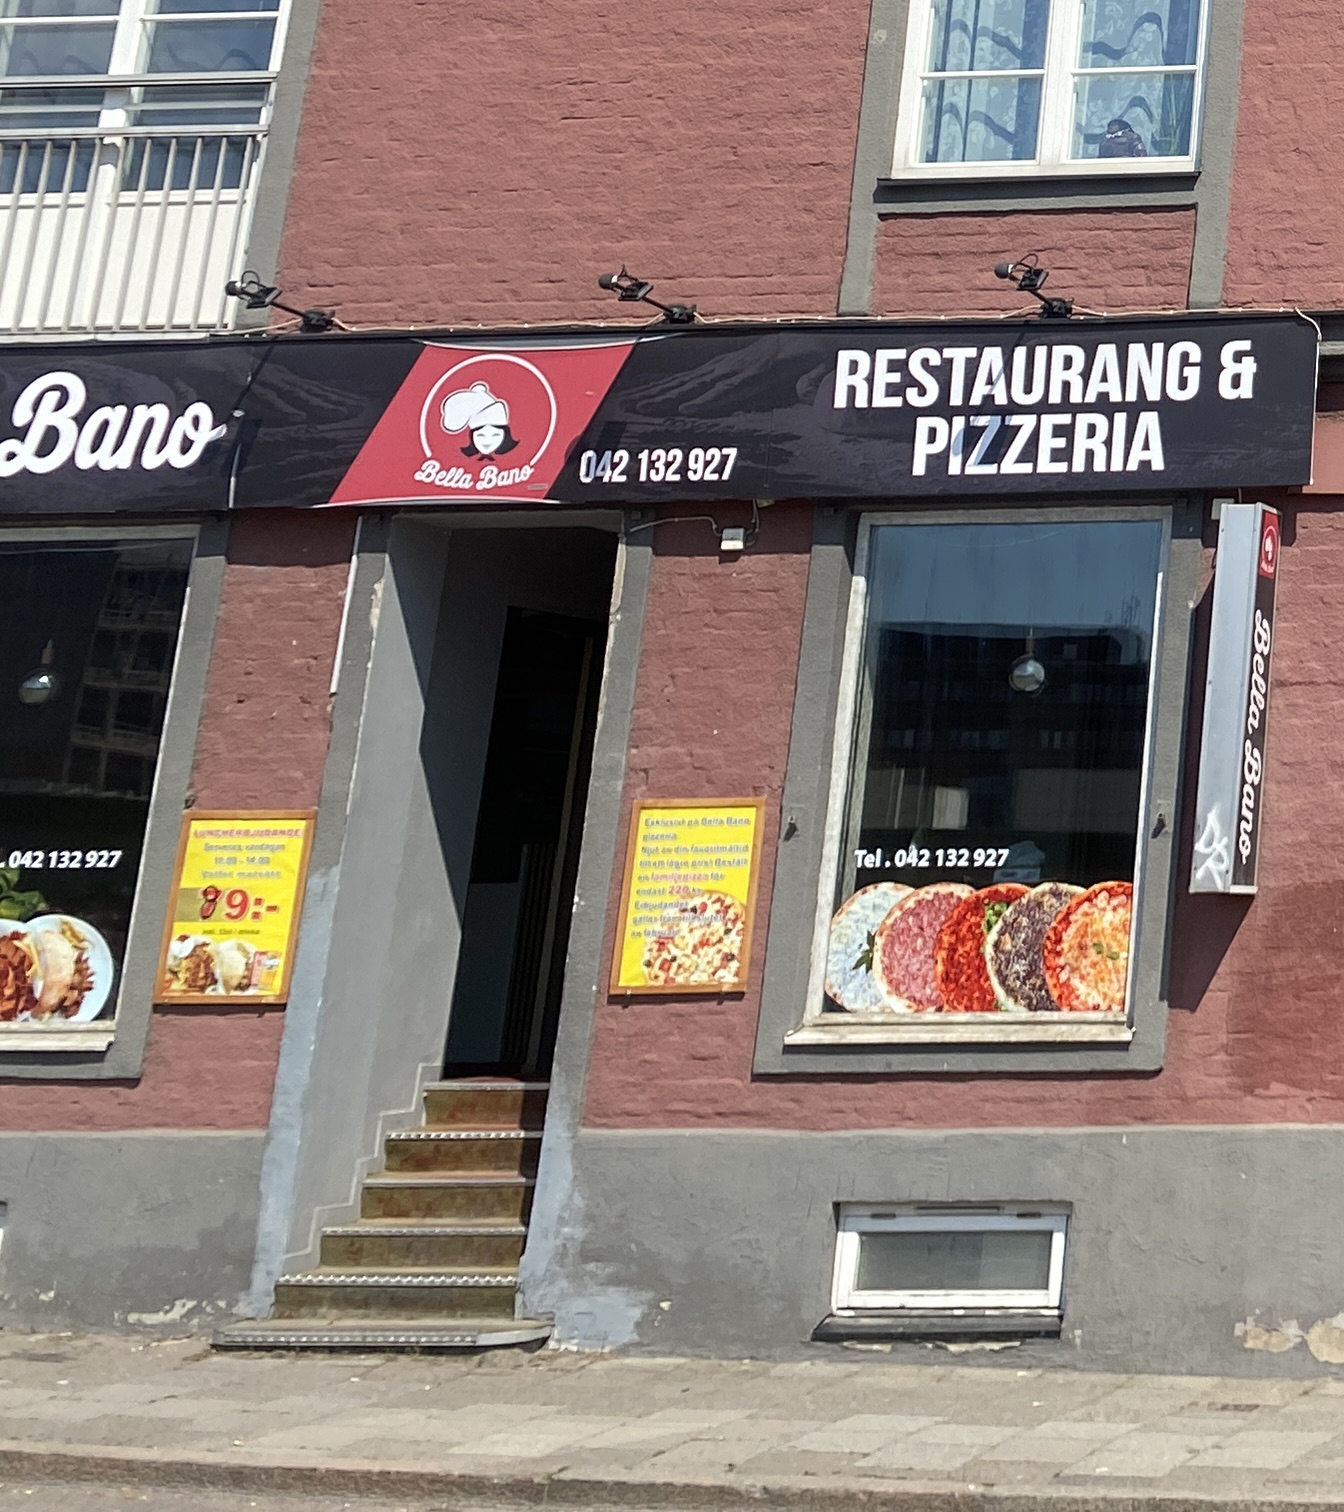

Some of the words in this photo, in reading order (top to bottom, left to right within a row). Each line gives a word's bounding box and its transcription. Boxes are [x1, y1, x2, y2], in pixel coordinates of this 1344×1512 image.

[833, 341, 1201, 409] RESTAURANG
[1218, 340, 1257, 400] &
[0, 372, 227, 477] Bano
[911, 411, 1166, 476] PIZZERIA
[413, 459, 474, 489] Bella
[475, 465, 534, 490] Bano
[579, 449, 630, 484] 042
[637, 448, 683, 482] 132
[687, 447, 738, 482] 927
[1248, 608, 1271, 734] Bella
[1238, 739, 1262, 865] Bano
[8, 850, 45, 869] 042
[48, 850, 83, 869] 132
[84, 849, 122, 868] 927
[894, 847, 930, 868] 042
[935, 848, 969, 868] 132
[973, 848, 1009, 868] 927
